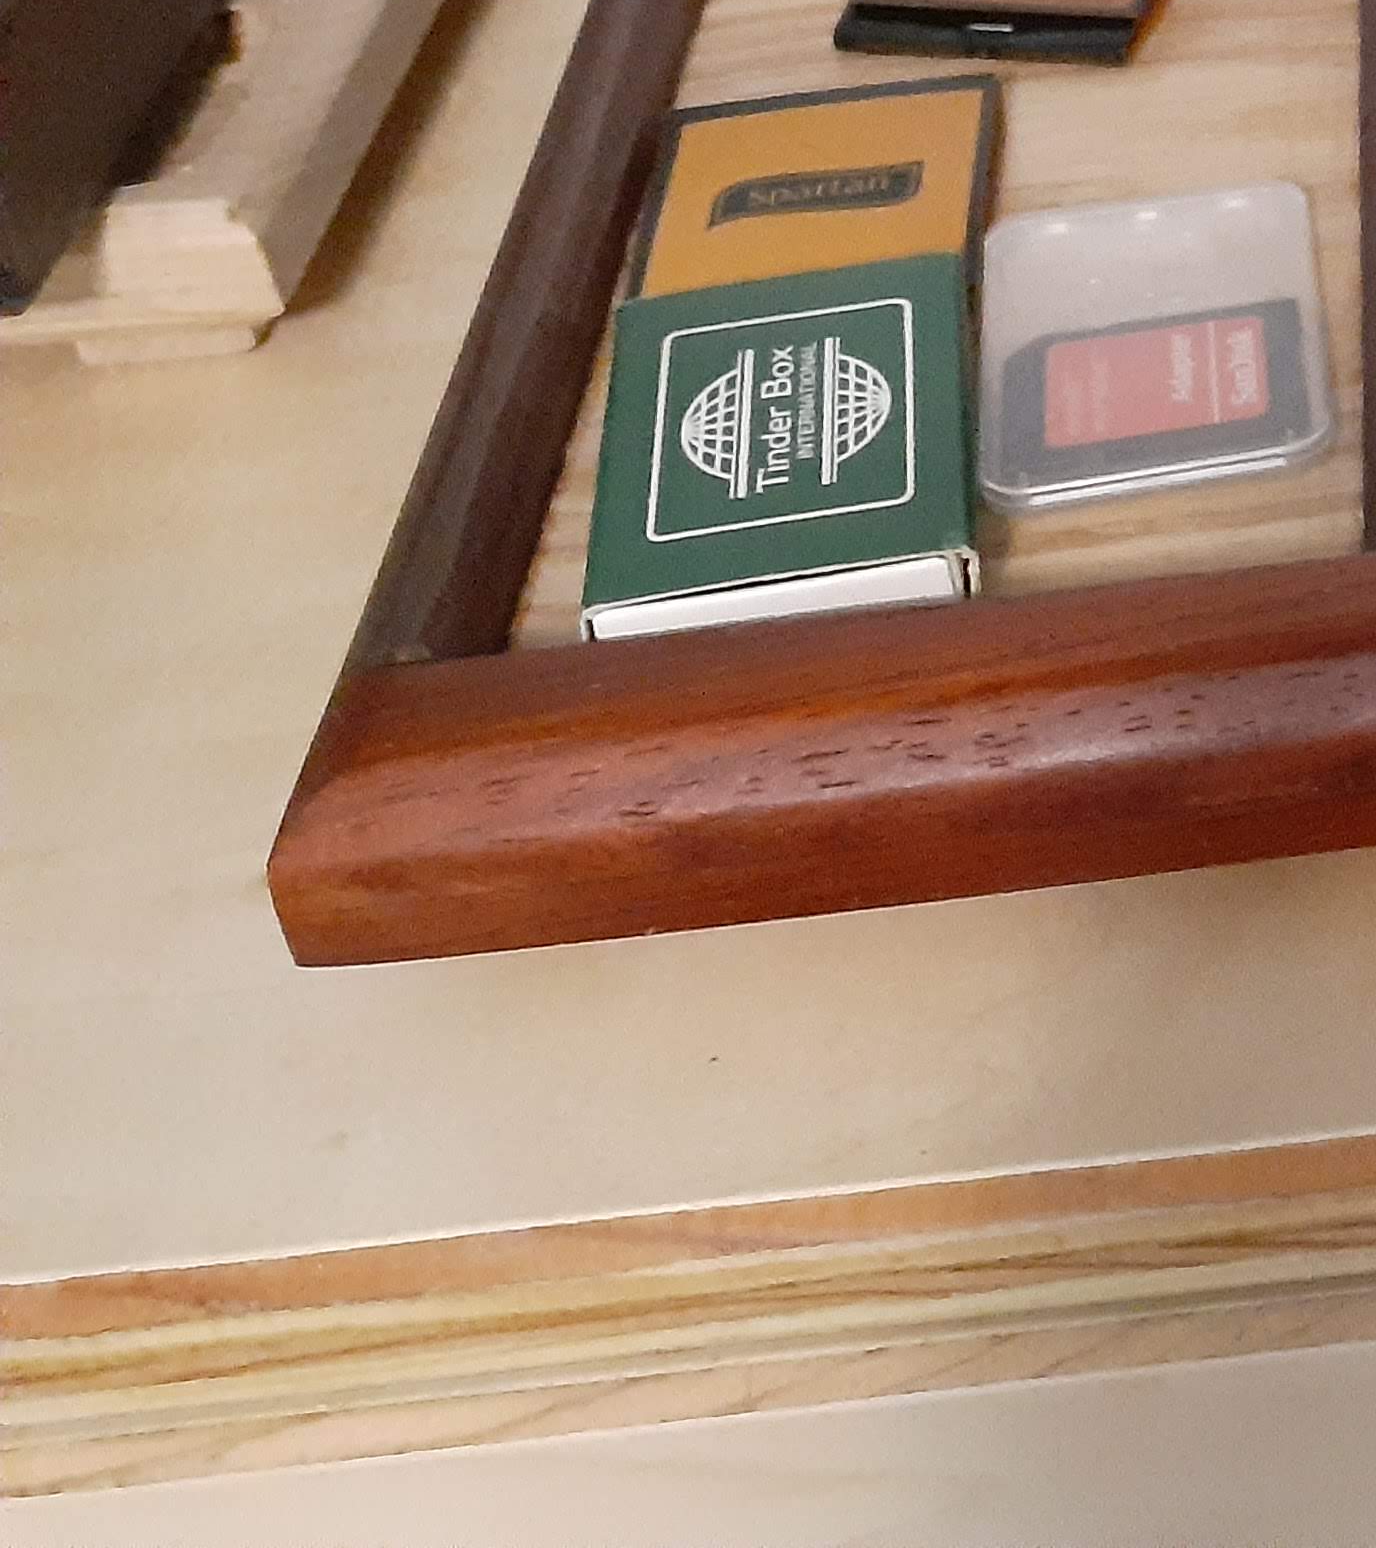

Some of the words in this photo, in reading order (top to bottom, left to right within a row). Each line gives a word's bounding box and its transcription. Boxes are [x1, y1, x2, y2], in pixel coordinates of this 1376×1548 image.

[760, 344, 794, 399] Box
[796, 340, 818, 460] INTERNATIONAL
[755, 405, 793, 493] Tinder
